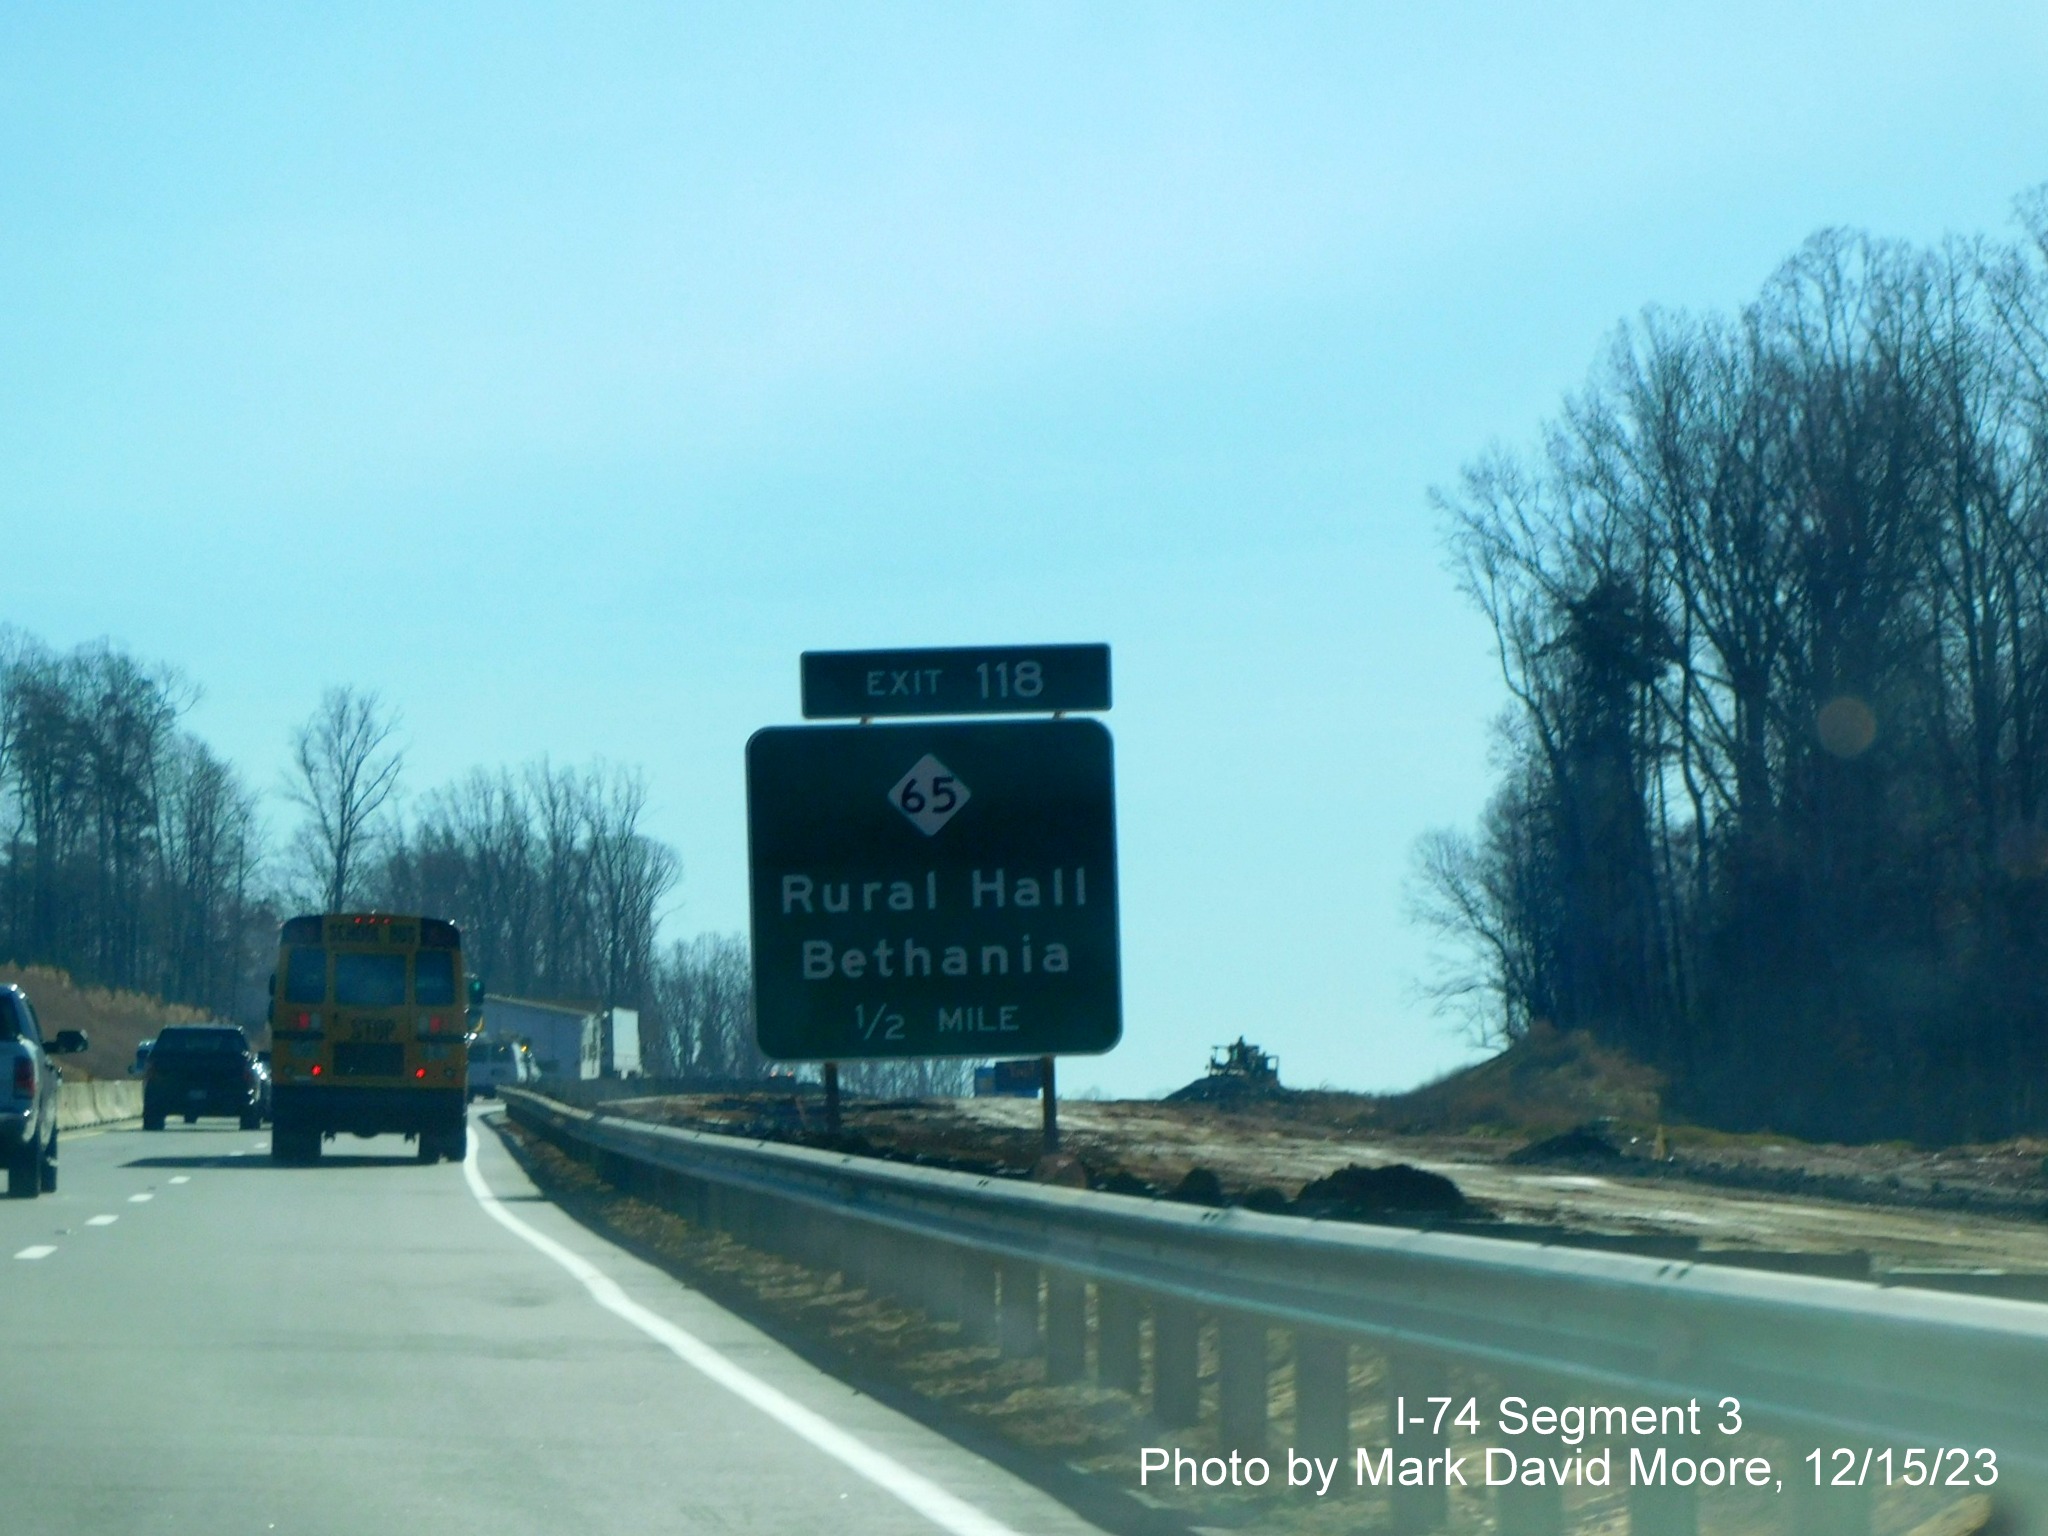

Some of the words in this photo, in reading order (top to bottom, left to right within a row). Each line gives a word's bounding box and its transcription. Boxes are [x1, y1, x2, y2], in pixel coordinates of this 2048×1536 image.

[866, 669, 943, 697] EXIT
[976, 661, 1044, 699] 118
[900, 776, 958, 815] 65
[781, 871, 938, 915] Rural
[971, 866, 1086, 909] Hall
[801, 933, 1071, 981] Bethania
[854, 1003, 907, 1041] 1/2
[938, 1005, 1019, 1033] MILE
